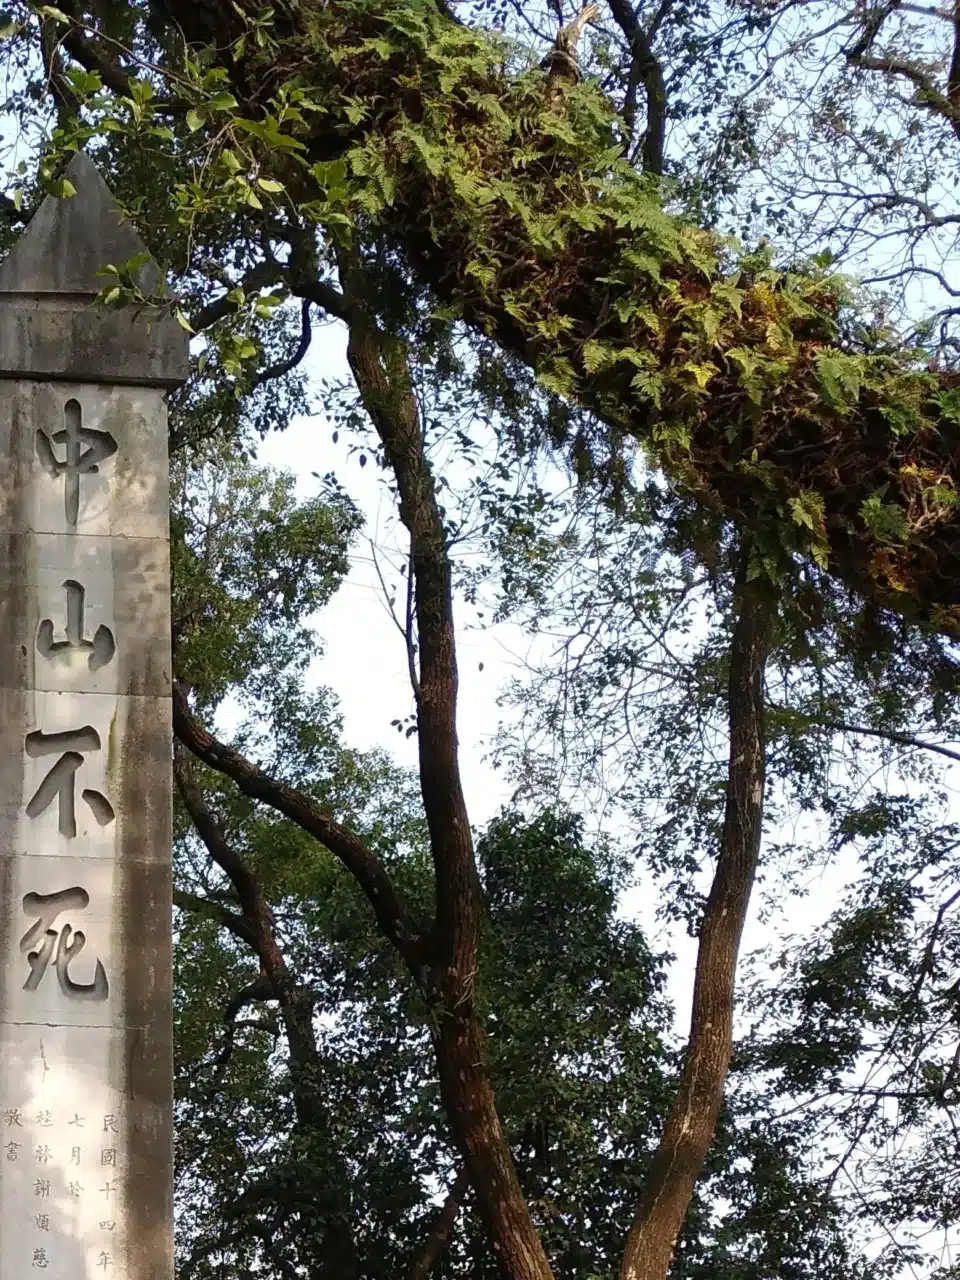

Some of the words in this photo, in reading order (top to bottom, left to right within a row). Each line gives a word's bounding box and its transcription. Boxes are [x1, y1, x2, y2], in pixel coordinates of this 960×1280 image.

[19, 397, 119, 1002] 中山不死
[3, 1108, 24, 1162] 敬書
[66, 1112, 86, 1198] 七月於
[96, 1114, 119, 1271] 民國十四年
